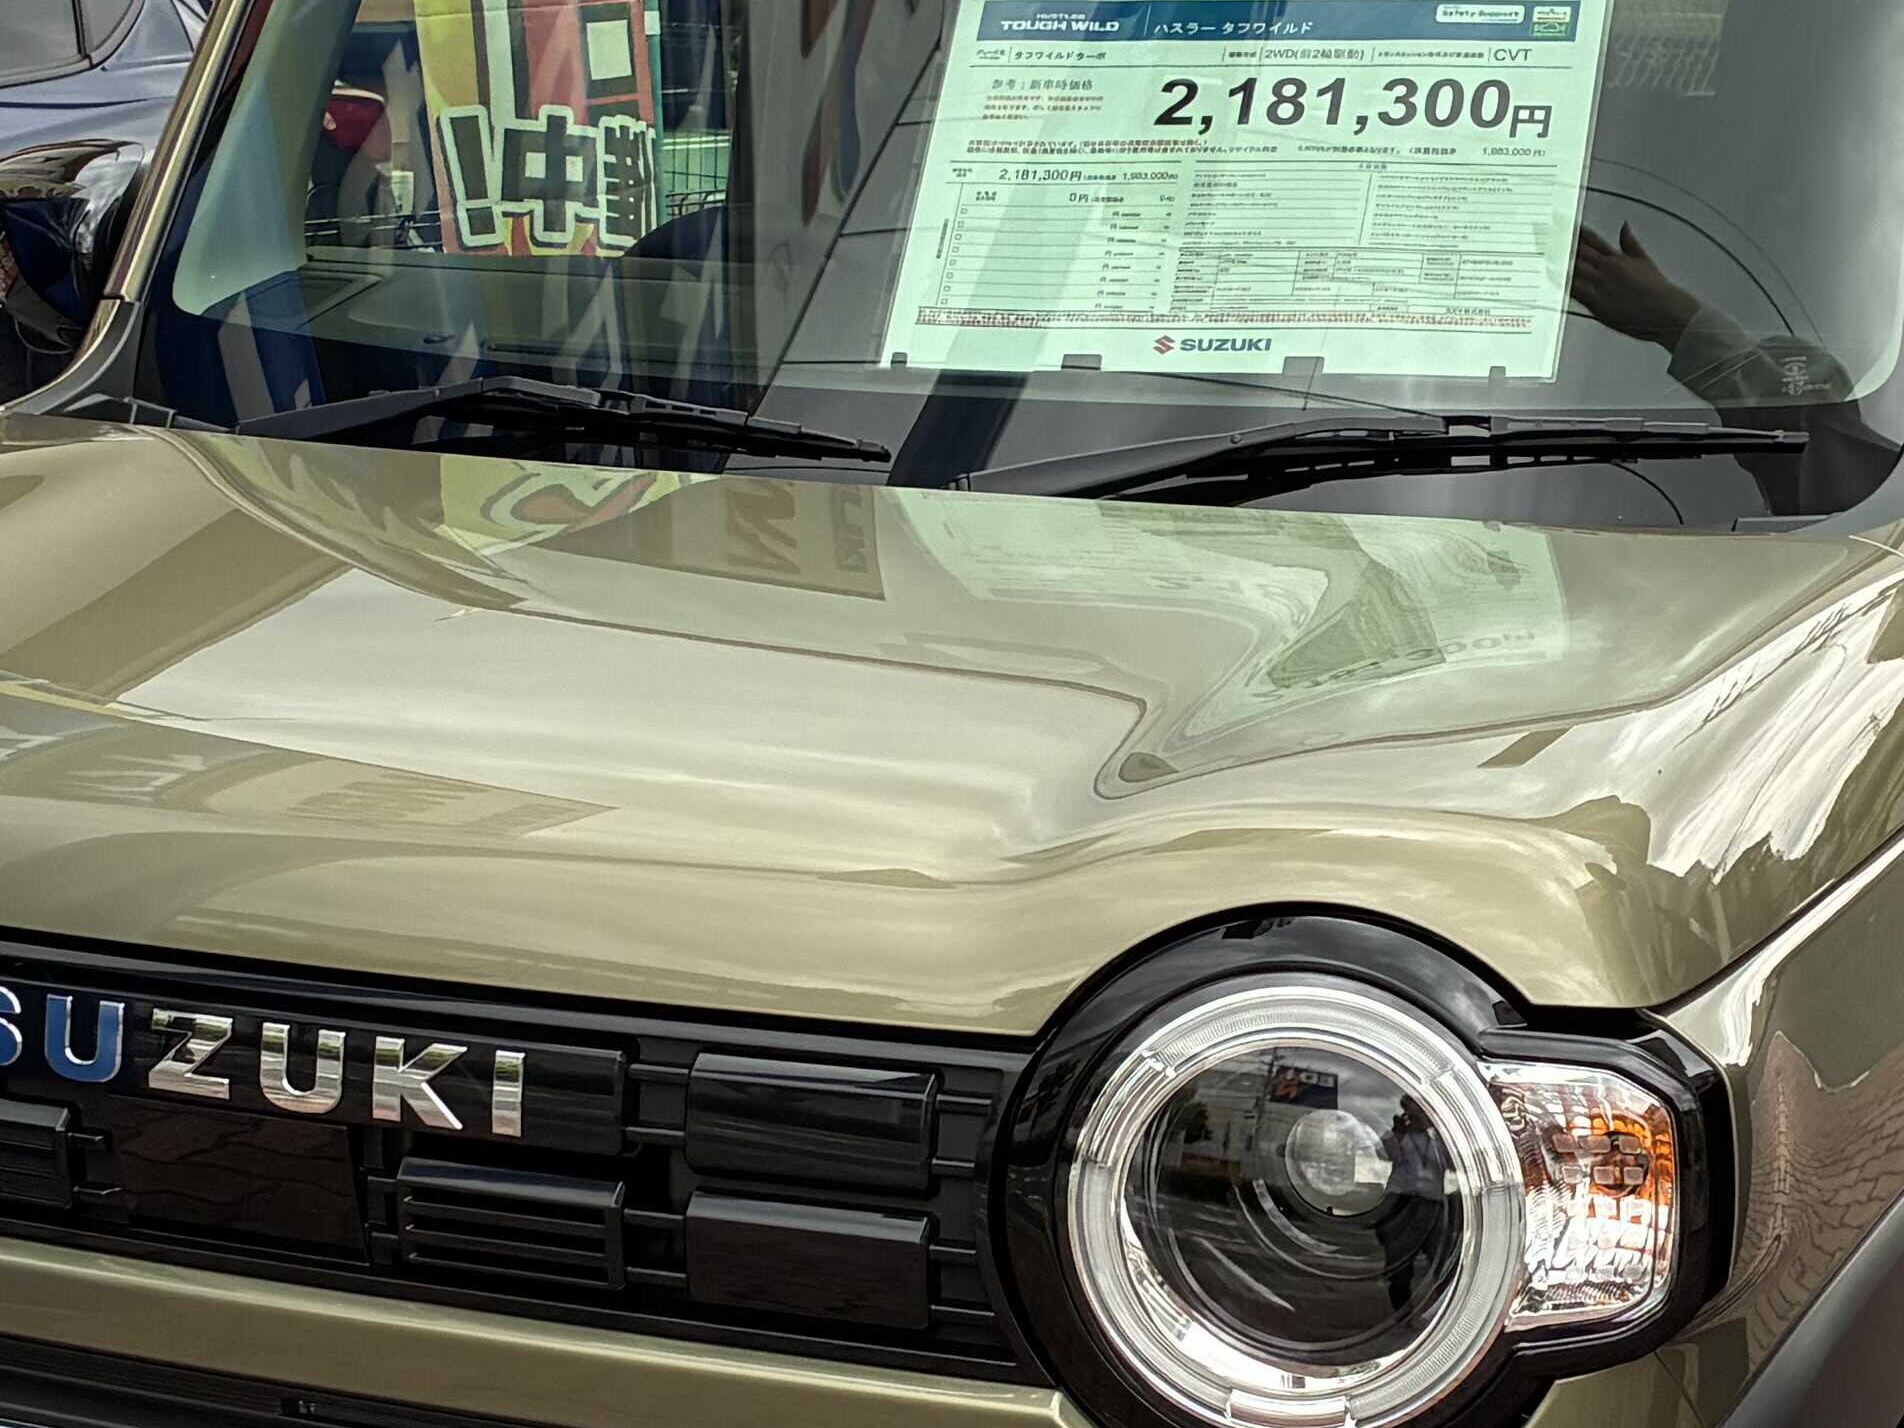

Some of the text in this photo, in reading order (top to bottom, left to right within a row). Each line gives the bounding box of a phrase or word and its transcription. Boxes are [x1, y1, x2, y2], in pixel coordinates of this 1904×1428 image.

[1000, 20, 1121, 33] TOUGH WILD
[1153, 21, 1314, 35] ハスラー タフワイルド
[1493, 48, 1533, 62] CVT
[1153, 76, 1553, 139] 2,181,300円
[1180, 338, 1273, 352] SUZUKI
